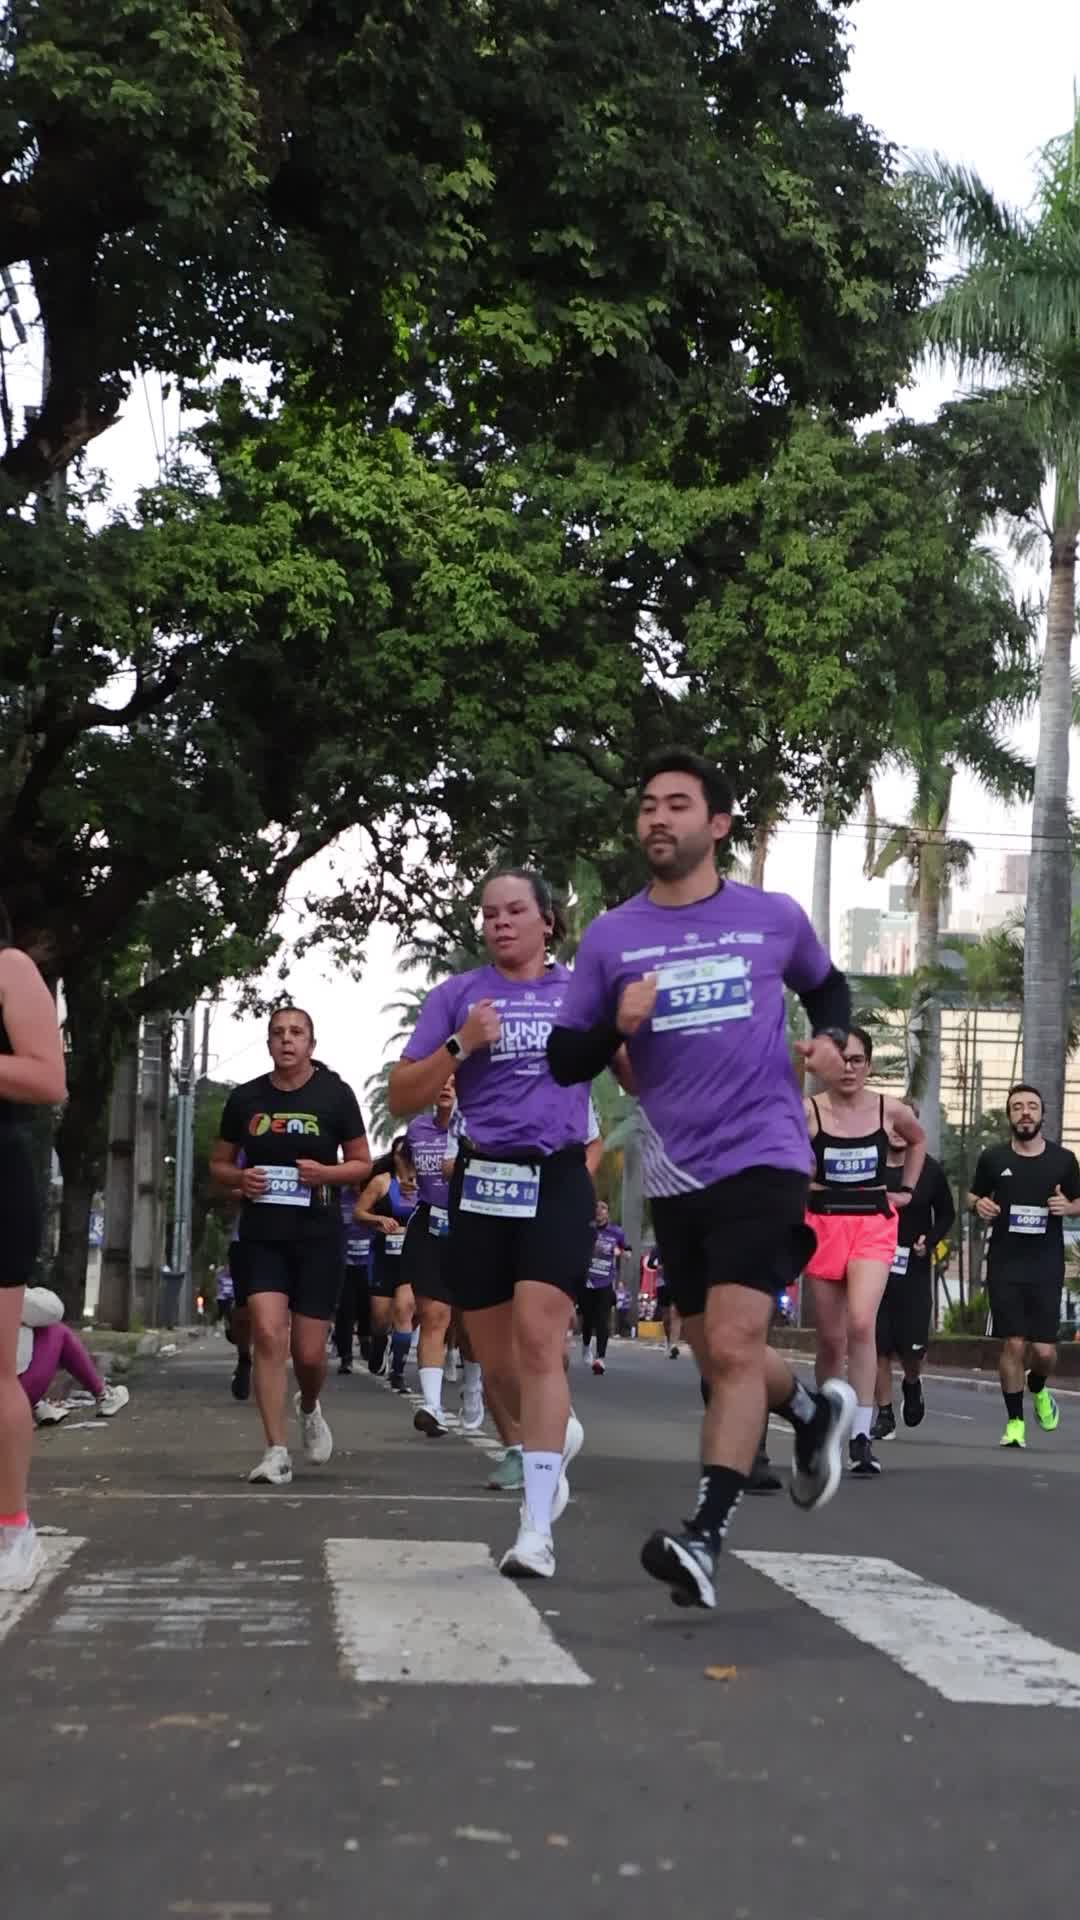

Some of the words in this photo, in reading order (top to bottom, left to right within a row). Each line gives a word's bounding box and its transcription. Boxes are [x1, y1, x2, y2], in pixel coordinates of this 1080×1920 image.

[669, 982, 725, 1007] 5737
[271, 1119, 320, 1136] EMA
[836, 1159, 866, 1170] 6381
[475, 1179, 519, 1198] 6354
[1017, 1215, 1041, 1225] 6009
